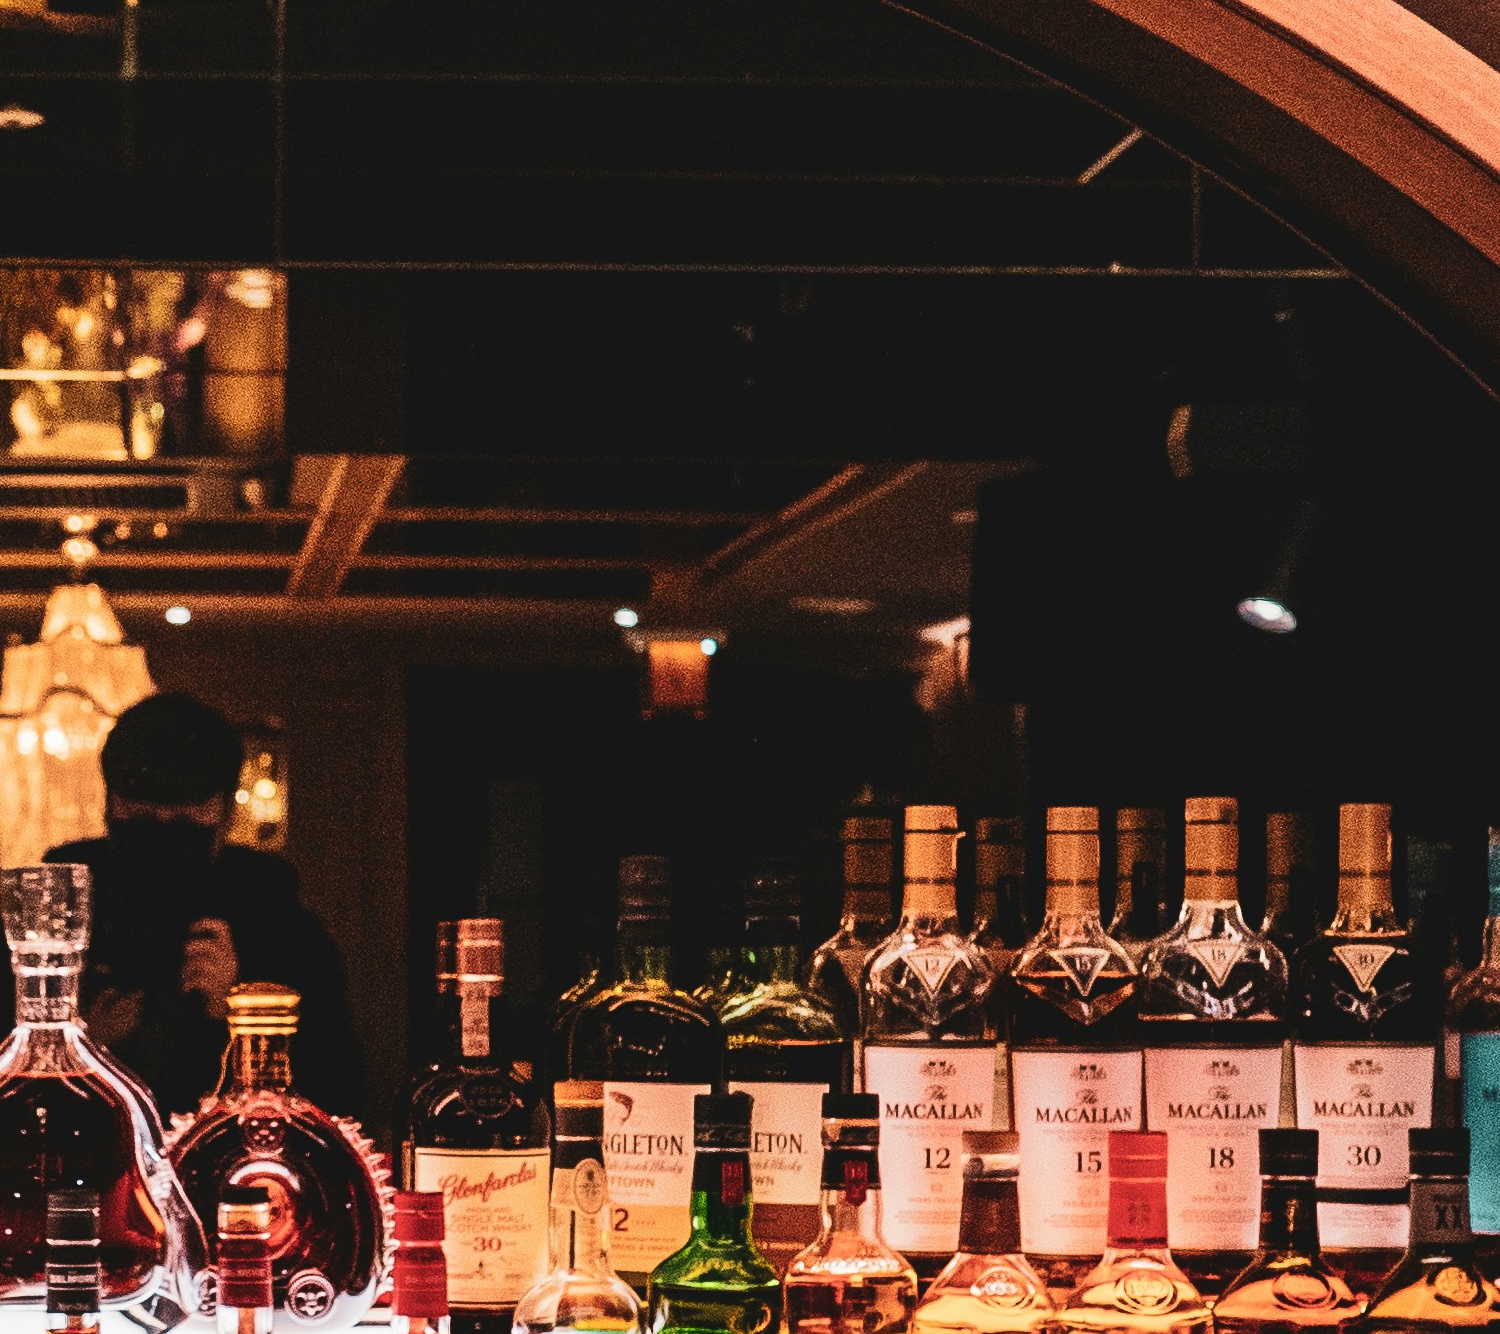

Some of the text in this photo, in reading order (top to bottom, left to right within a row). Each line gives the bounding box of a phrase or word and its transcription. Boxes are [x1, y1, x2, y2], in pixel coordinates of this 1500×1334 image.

[885, 1102, 983, 1120] MACALLAN
[1035, 1105, 1133, 1124] MACALLAN
[1168, 1102, 1267, 1120] MACALLAN
[1313, 1100, 1416, 1118] MACALLAN
[604, 1133, 685, 1156] NGLETON
[922, 1147, 951, 1170] 12
[1075, 1151, 1102, 1174] 15
[1208, 1146, 1235, 1170] 18
[1346, 1144, 1382, 1168] 30
[610, 1177, 656, 1188] FTOWN
[613, 1208, 630, 1232] 2
[473, 1237, 502, 1252] 30
